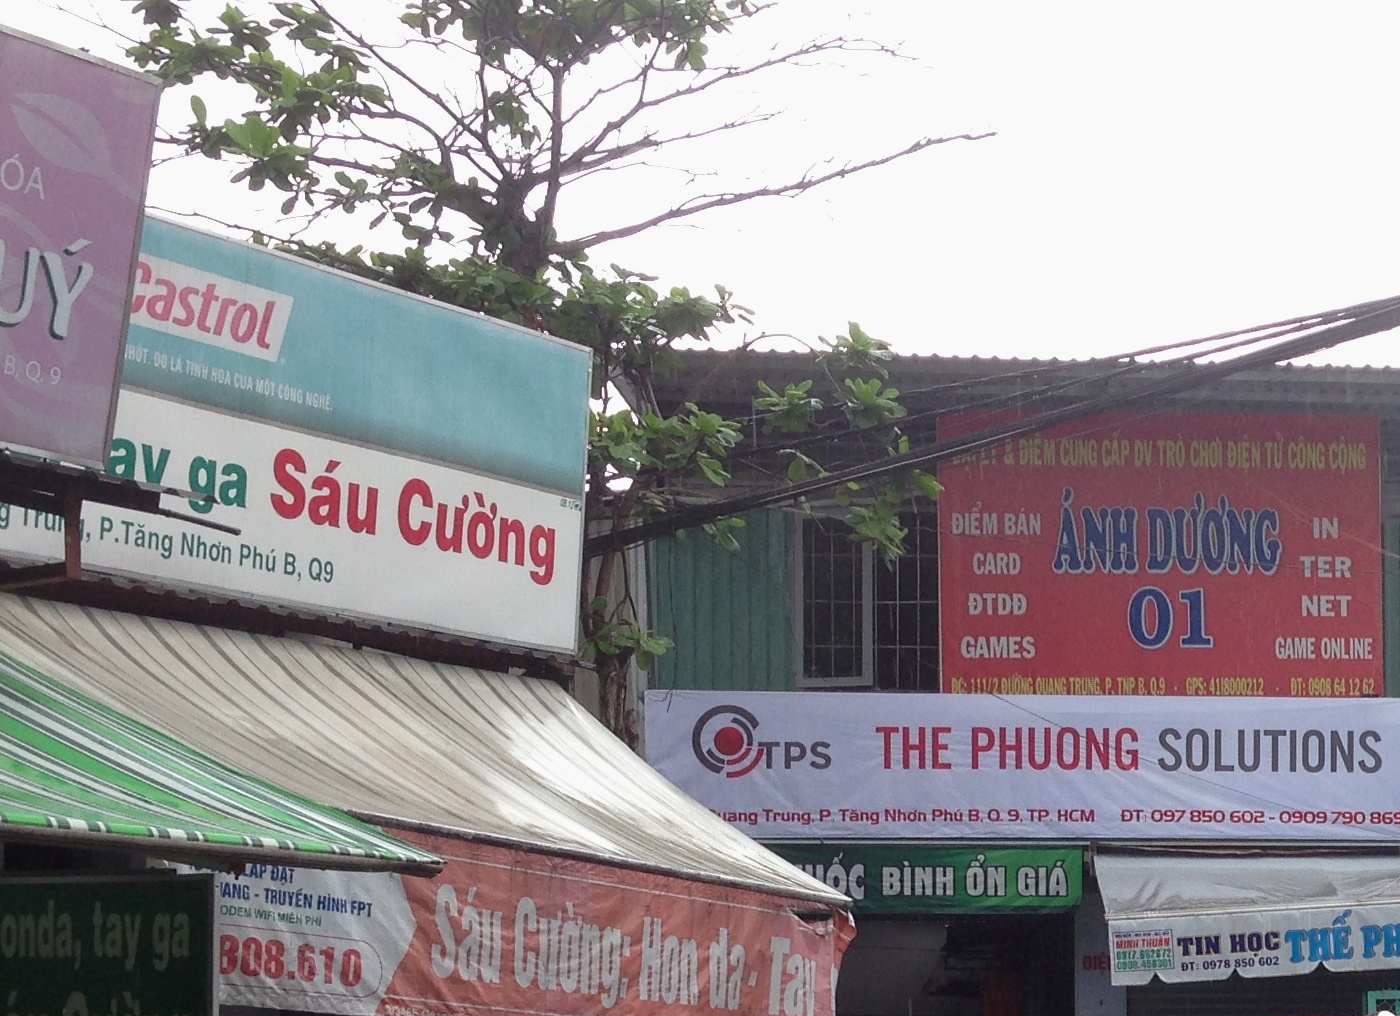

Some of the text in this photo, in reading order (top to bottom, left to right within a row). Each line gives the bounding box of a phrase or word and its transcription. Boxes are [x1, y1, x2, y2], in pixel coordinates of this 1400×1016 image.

[1, 153, 45, 200] ÓA
[1060, 438, 1098, 467] CUNG
[188, 455, 248, 514] ga
[270, 448, 380, 540] Sáu
[397, 477, 556, 587] Cường
[951, 500, 999, 536] ĐIỂM
[1004, 506, 1042, 536] BÁN
[1146, 490, 1283, 576] DƯƠNG
[1312, 516, 1339, 540] IN
[180, 531, 233, 564] Nhơn
[239, 544, 276, 574] Phú
[282, 556, 302, 582] B,
[308, 557, 335, 584] Q9
[972, 552, 1353, 579] CARD TER
[966, 585, 1353, 650] ĐTDĐ 01 NET
[960, 635, 1374, 660] GAMES GAME ONLINE
[1036, 677, 1067, 695] QUANG
[1117, 677, 1136, 695] TNP
[1334, 677, 1346, 696] 64
[1348, 677, 1360, 696] 12
[1362, 677, 1375, 695] 62
[757, 725, 1384, 774] TPS THE PHUONG SOLUTIONS
[763, 809, 816, 826] Trung,
[839, 806, 880, 826] Tăng
[885, 807, 928, 823] Nhơn
[932, 807, 963, 824] Phú
[1057, 809, 1096, 824] HCM
[1150, 810, 1187, 824] 097
[1190, 810, 1227, 825] 850
[1230, 811, 1266, 825] 602
[1279, 811, 1328, 825] 0909
[1332, 811, 1368, 826] 790
[881, 854, 1068, 897] BÌNH ỔN GIÁ
[316, 893, 348, 914] HÌNH
[350, 902, 373, 918] FPT
[92, 900, 142, 971] tay
[152, 912, 191, 972] ga
[431, 883, 503, 985] Sáu
[638, 916, 699, 1006] Hon
[708, 927, 747, 1011] da
[1176, 935, 1222, 957] TIN
[1229, 931, 1281, 958] HỌC
[1284, 908, 1353, 964] THẾ
[1202, 958, 1232, 971] 0978
[1234, 957, 1256, 969] 850
[1258, 955, 1281, 967] 602
